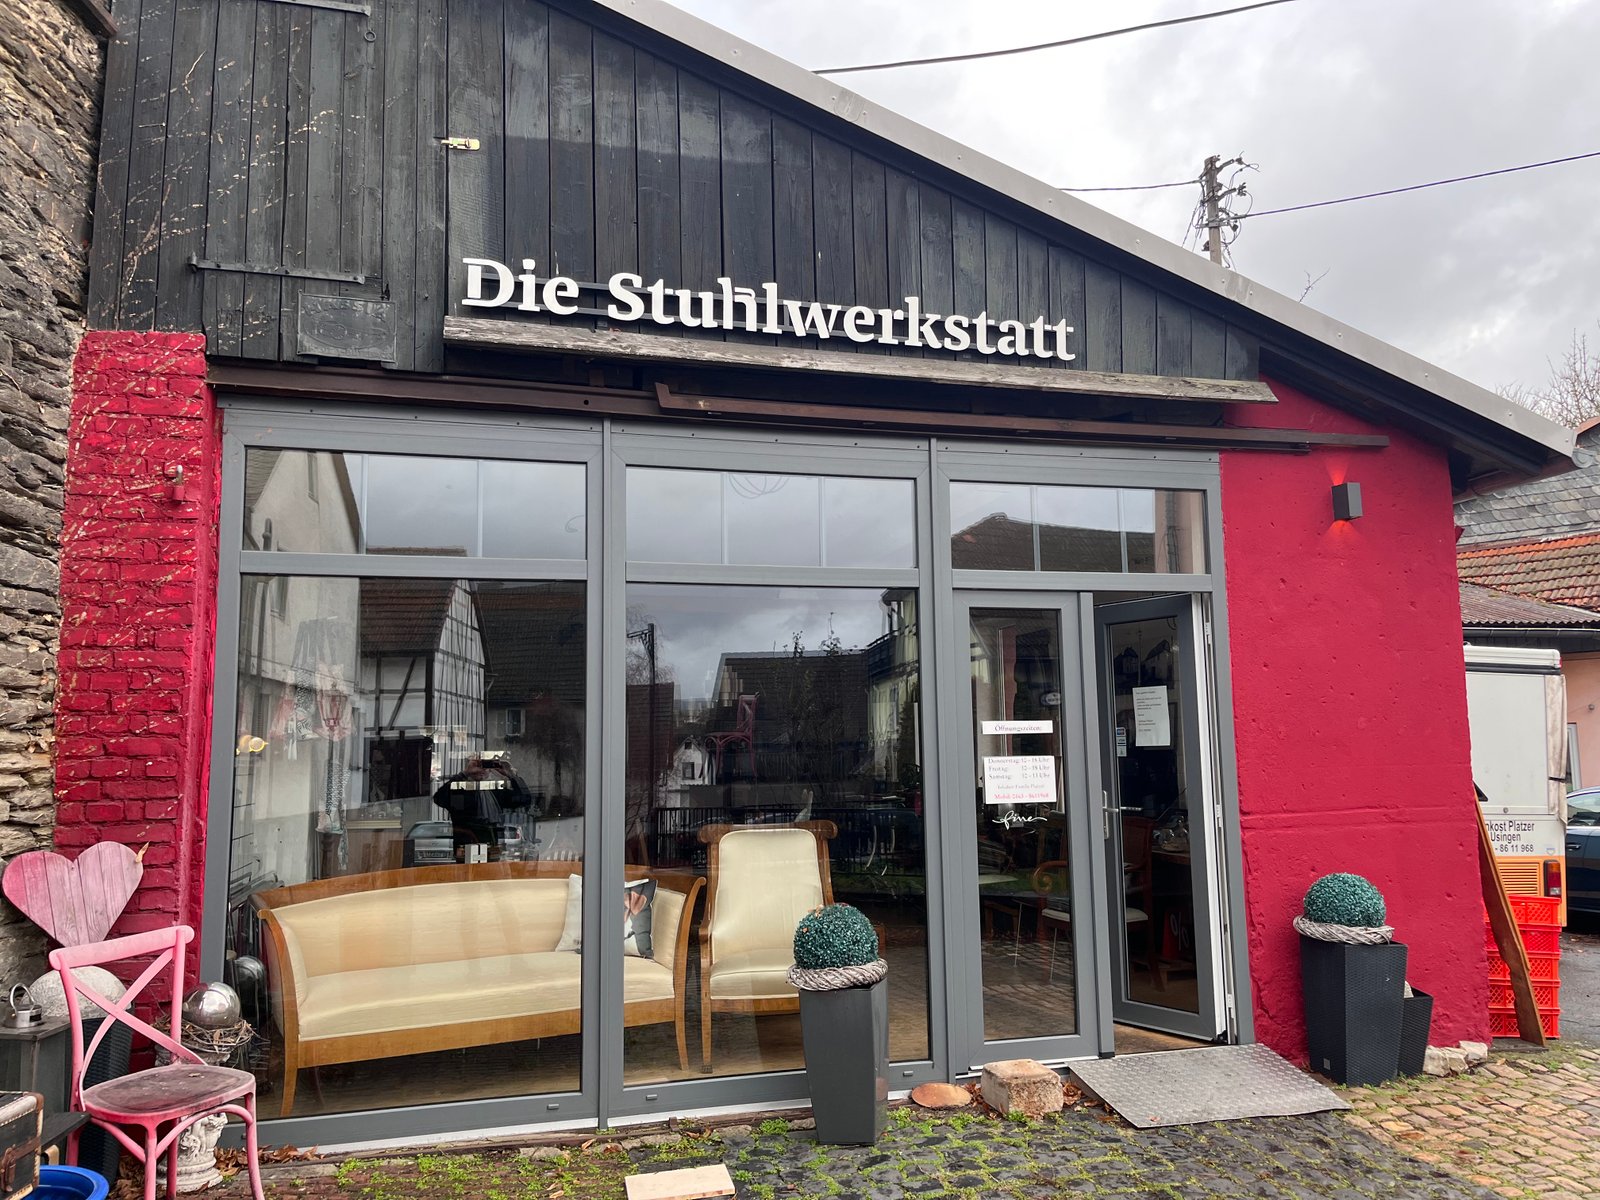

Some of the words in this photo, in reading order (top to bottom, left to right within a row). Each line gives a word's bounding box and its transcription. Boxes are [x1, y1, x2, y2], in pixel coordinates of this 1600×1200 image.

[461, 257, 580, 315] Die
[607, 272, 1075, 362] Stuhlwerkstatt
[1509, 820, 1535, 832] Platzer
[1490, 832, 1521, 844] Usingen
[1499, 844, 1509, 852] 86
[1511, 844, 1518, 852] 11
[1520, 844, 1534, 852] 968
